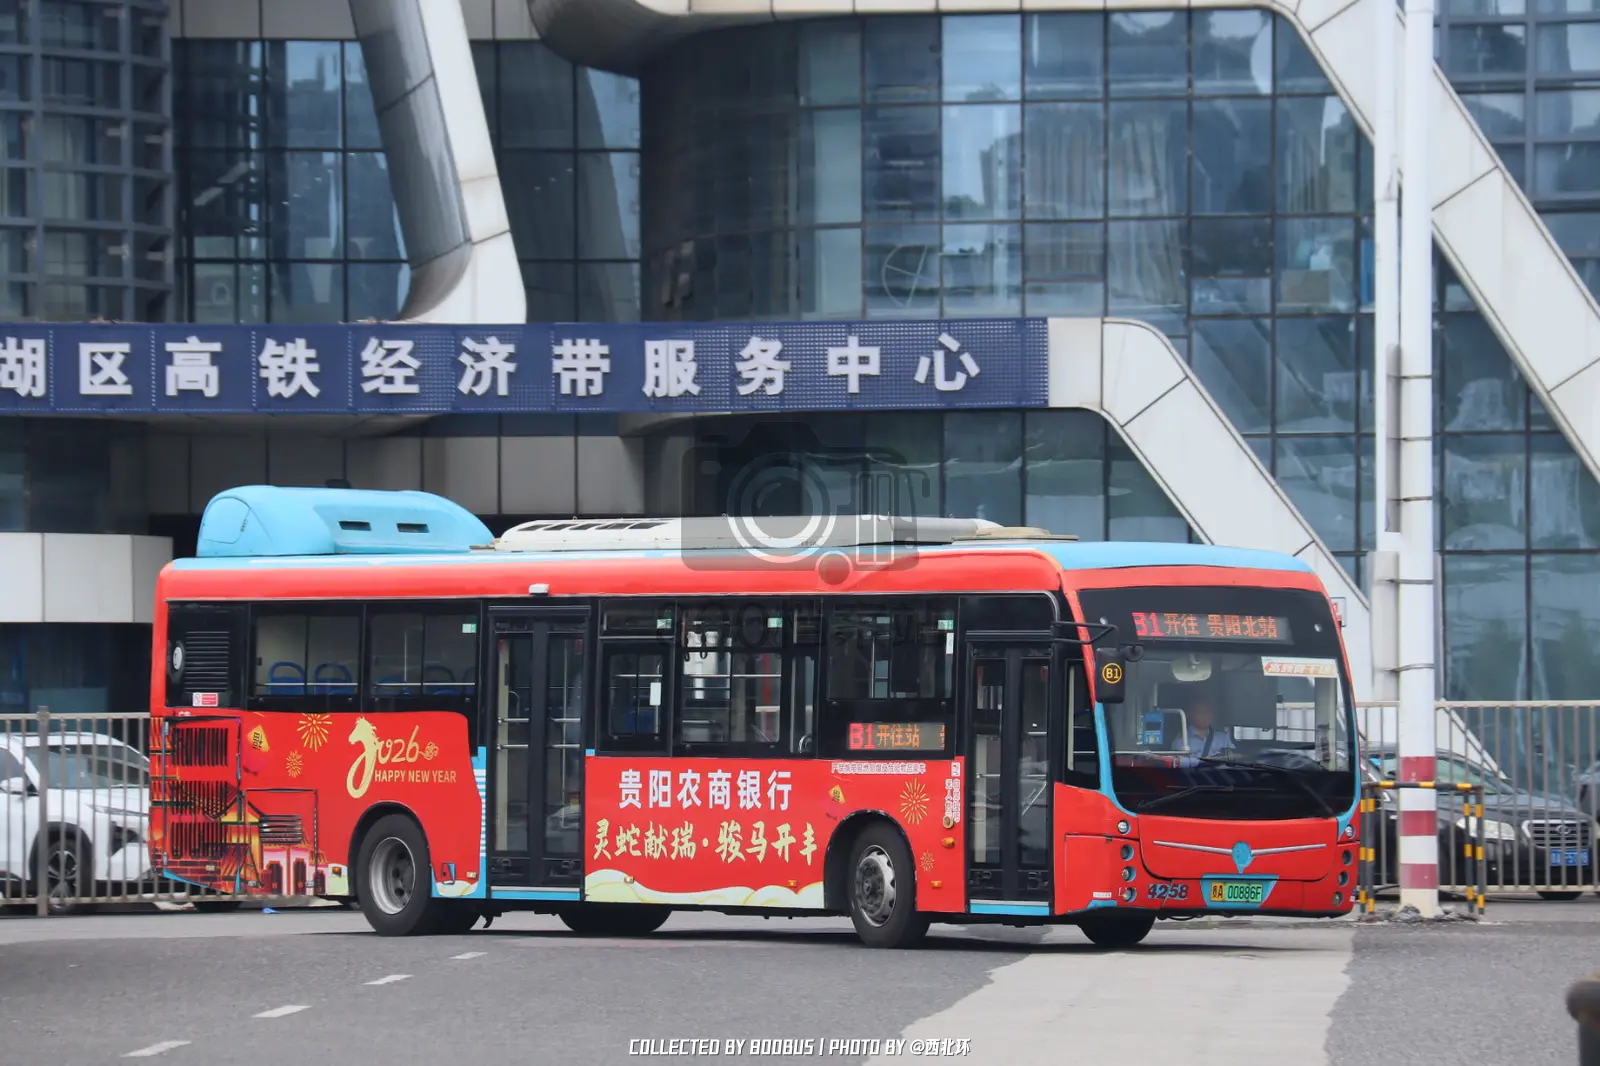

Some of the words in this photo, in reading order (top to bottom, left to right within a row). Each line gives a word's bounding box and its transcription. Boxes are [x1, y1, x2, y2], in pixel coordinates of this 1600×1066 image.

[0, 333, 980, 398] 湖区高铁经济带服务中心
[1105, 667, 1119, 679] B1
[849, 723, 875, 749] B1
[374, 770, 406, 783] HAPPY
[408, 770, 430, 783] NEW
[432, 770, 457, 783] YEAR
[618, 769, 792, 811] 贵阳农商银行
[593, 818, 818, 867] 灵蛇献瑞·骏马开丰
[1147, 884, 1190, 900] 4258
